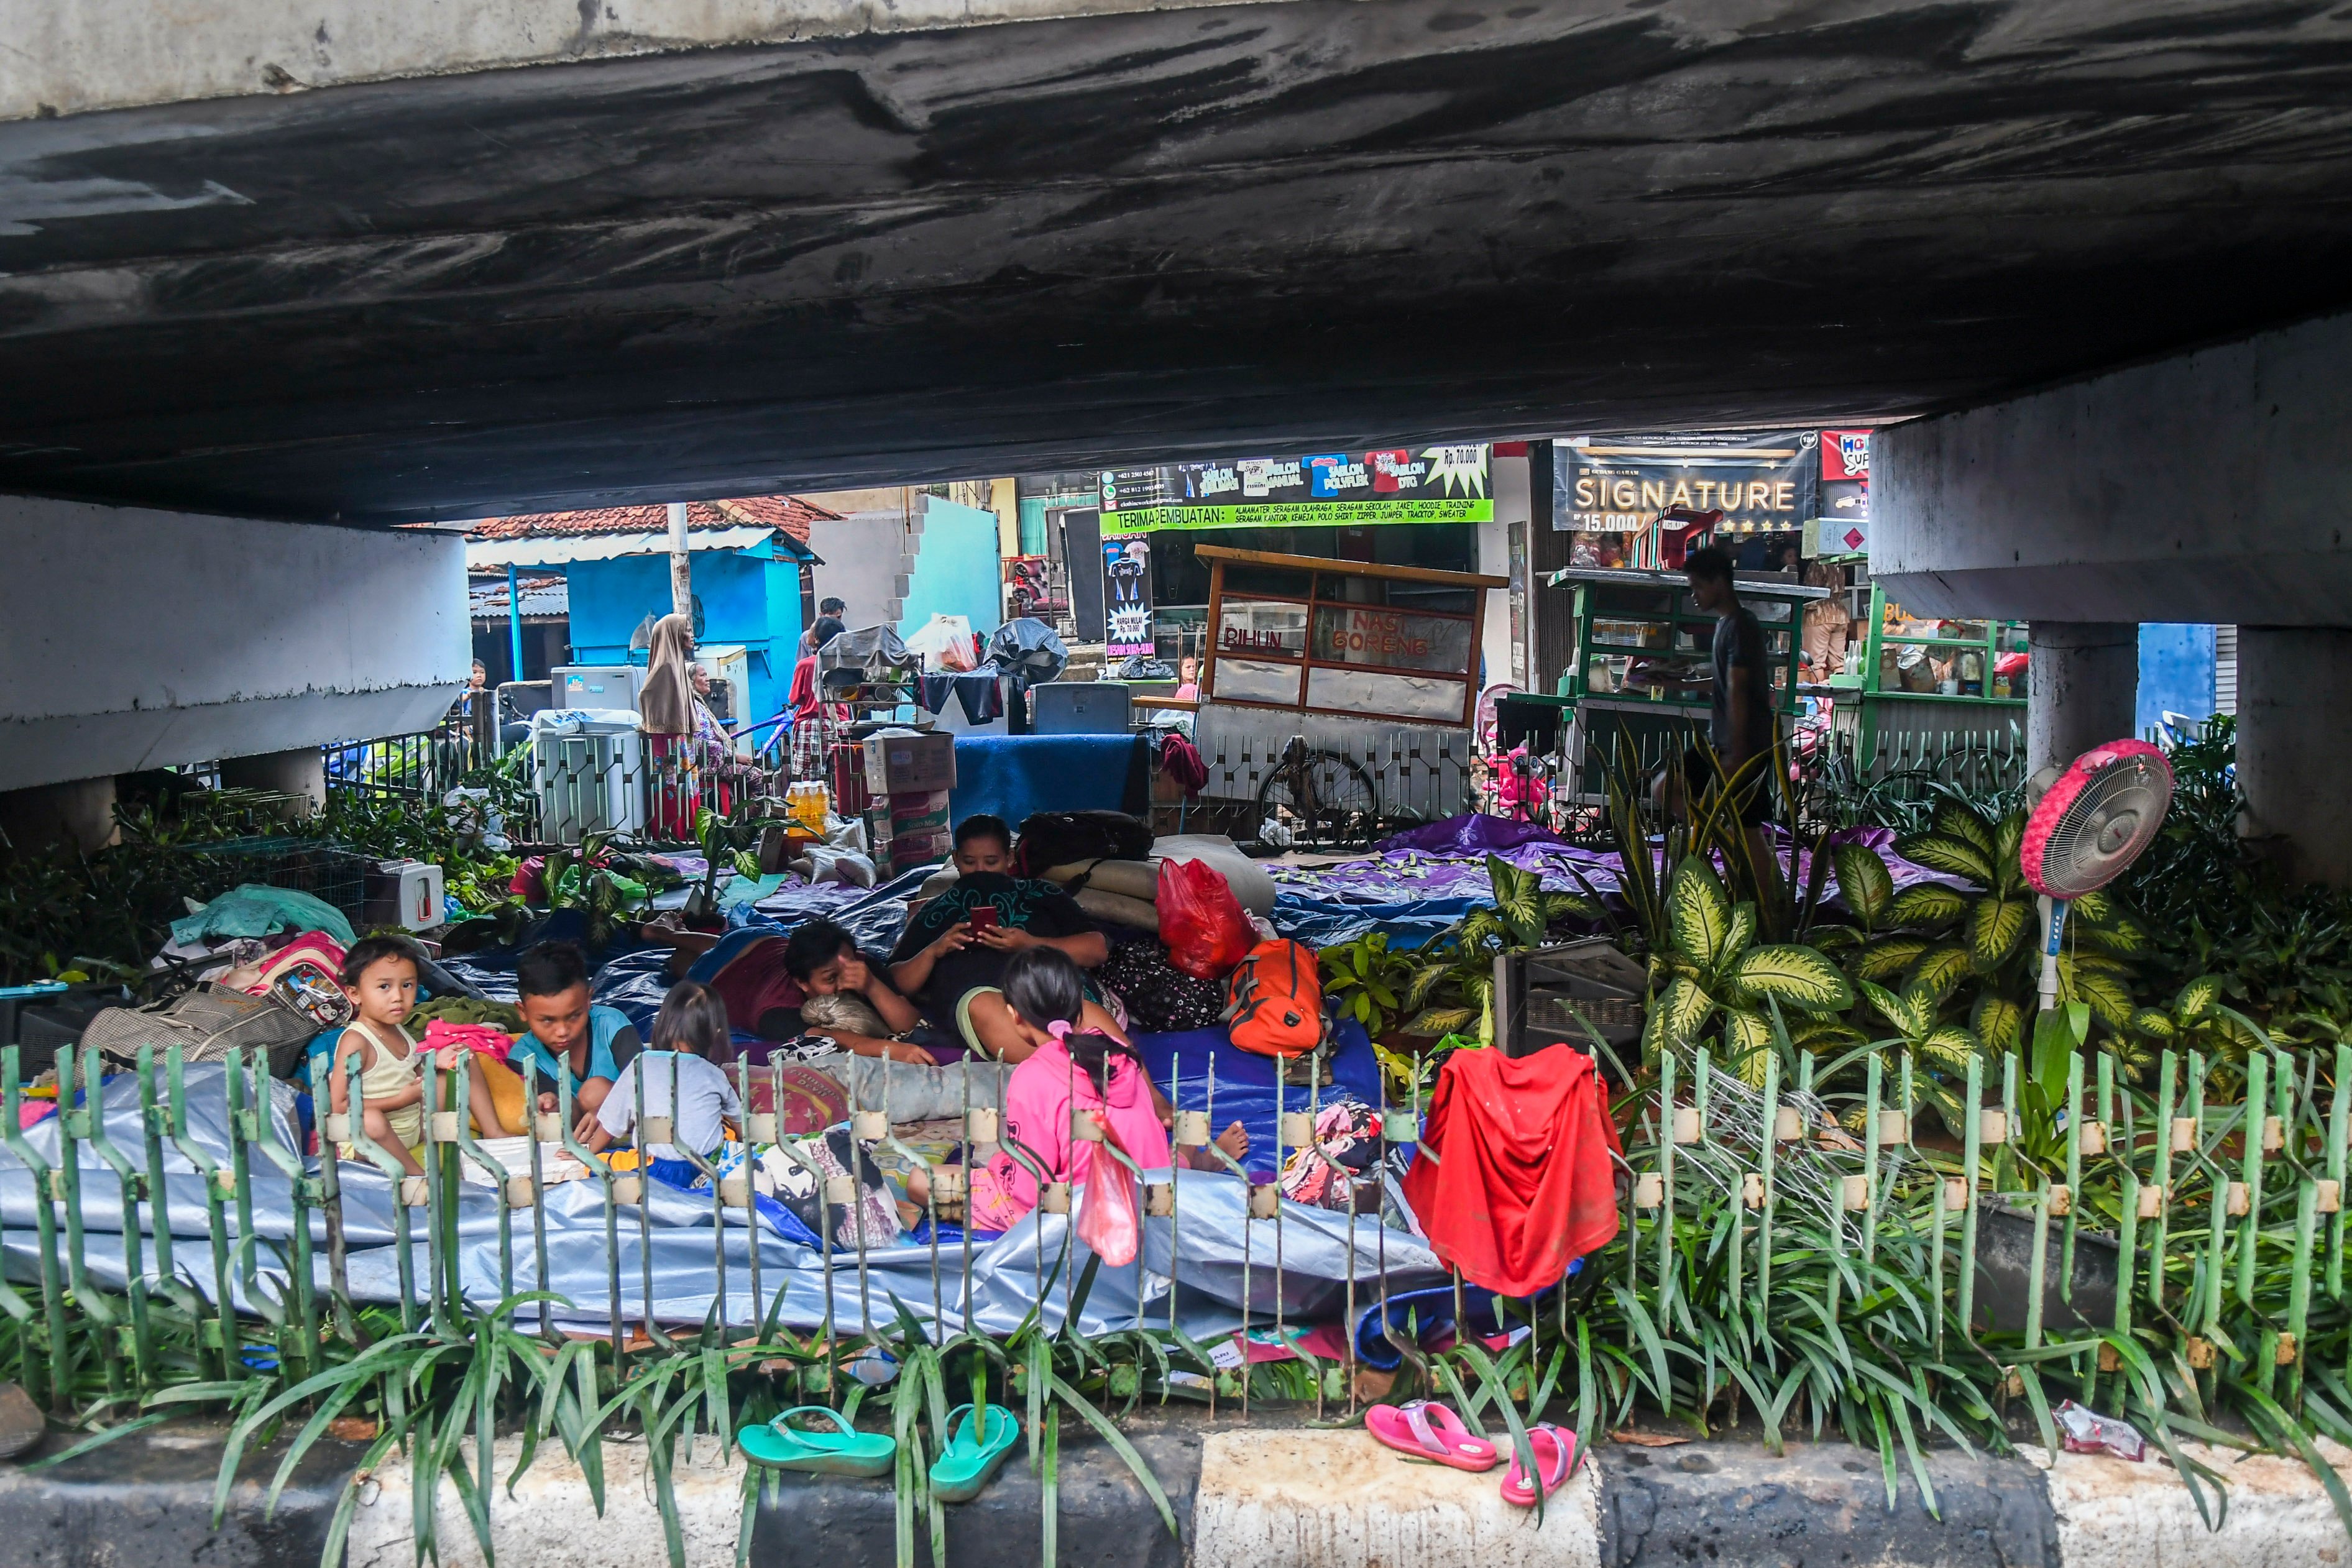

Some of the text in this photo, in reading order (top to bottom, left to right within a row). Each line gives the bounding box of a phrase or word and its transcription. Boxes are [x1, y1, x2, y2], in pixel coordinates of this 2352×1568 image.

[1445, 449, 1477, 467] Rp. 70.000
[1328, 463, 1364, 478] SABLON
[1266, 474, 1304, 488] MANUAL
[1398, 476, 1418, 489] DTG
[1574, 479, 1796, 511] SIGNATURE
[1273, 505, 1300, 513] SERAGAM
[1336, 503, 1363, 511] SERAGAM
[1445, 501, 1475, 509] TRAINING
[1117, 511, 1155, 528] TERIMA
[1235, 514, 1262, 523] SERAGAM
[1264, 513, 1289, 523] KANTOR,
[1291, 513, 1315, 522] KEMEJA,
[1318, 512, 1332, 521] POLO
[1334, 511, 1354, 521] SHIRT,
[1380, 510, 1404, 519] JUMPER,
[1407, 510, 1436, 519] TRACKTOP,
[1438, 509, 1466, 518] SWEATER
[1884, 602, 1916, 621] BU
[1117, 616, 1142, 625] HARGA MULAI
[1353, 611, 1407, 633] NASI
[1224, 627, 1282, 651] BIHUN
